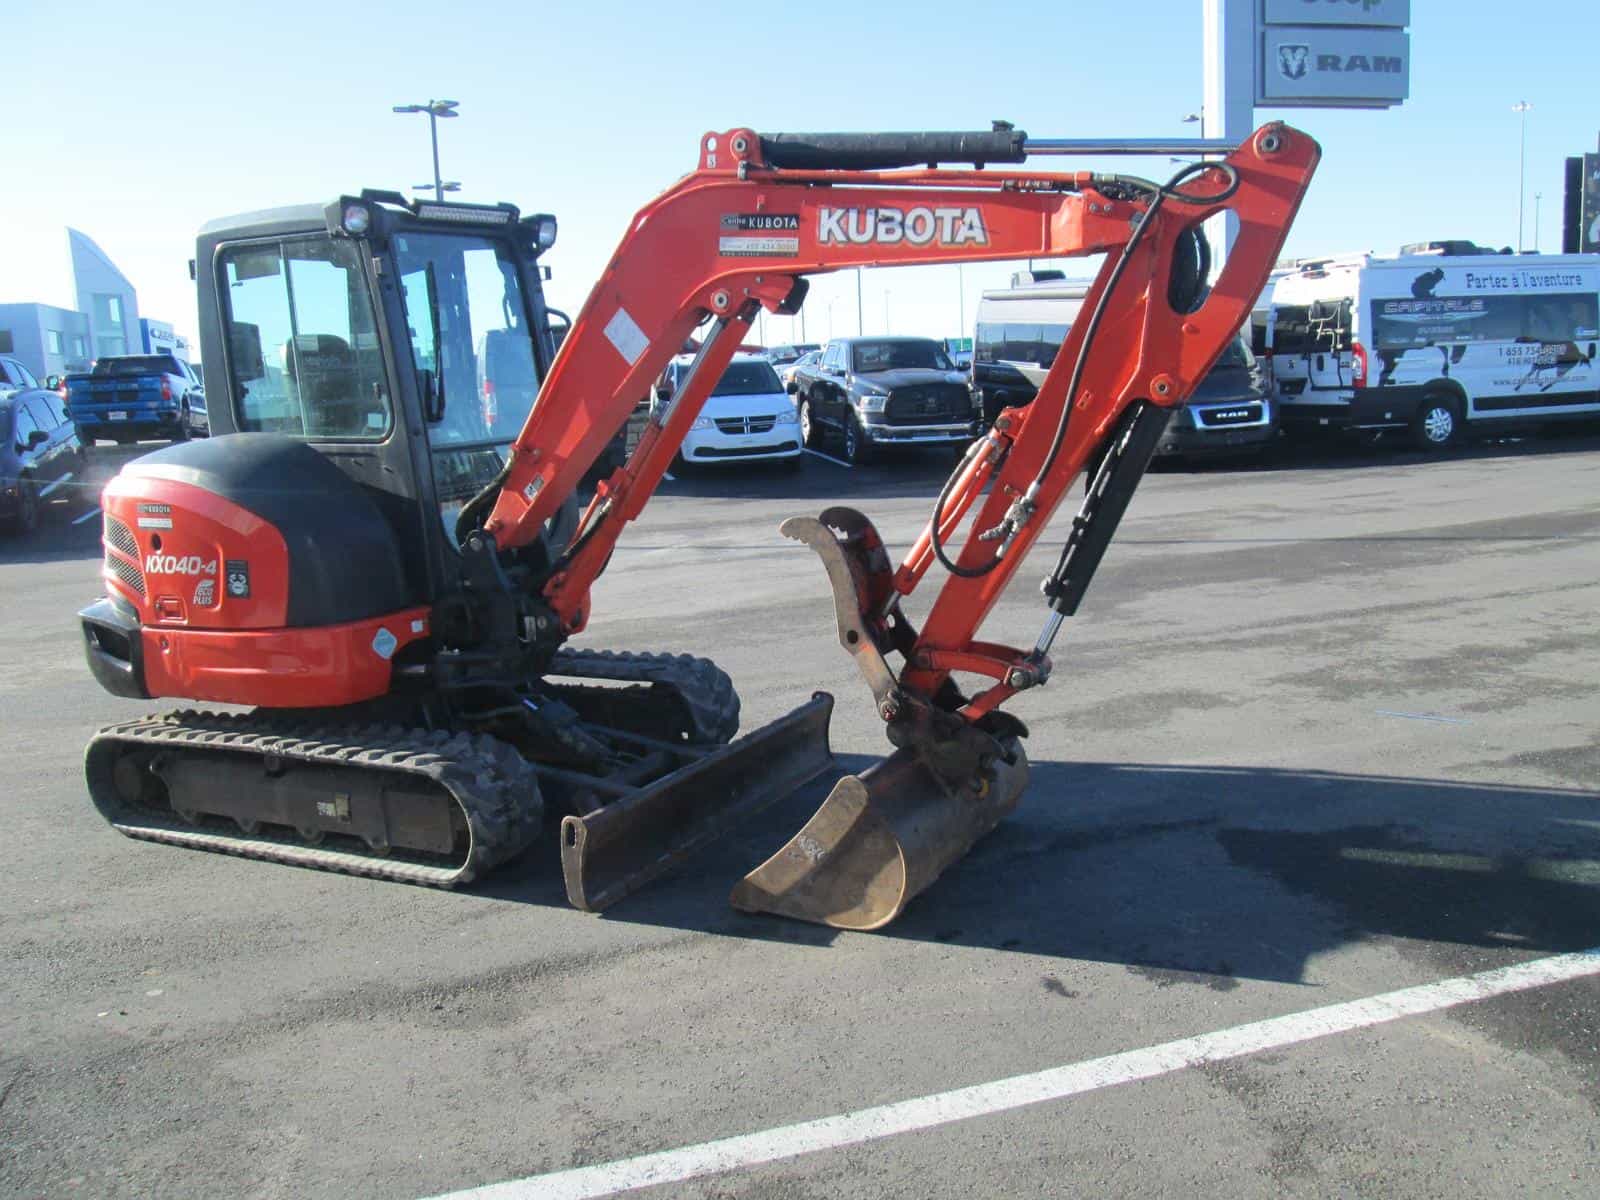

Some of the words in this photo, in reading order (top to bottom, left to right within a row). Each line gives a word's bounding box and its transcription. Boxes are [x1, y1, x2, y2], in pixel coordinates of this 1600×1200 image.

[1316, 54, 1402, 73] RAM
[749, 216, 798, 229] KUBOTA
[816, 207, 987, 245] KUBOTA
[1466, 272, 1509, 289] Partez
[146, 555, 216, 575] KX040-4
